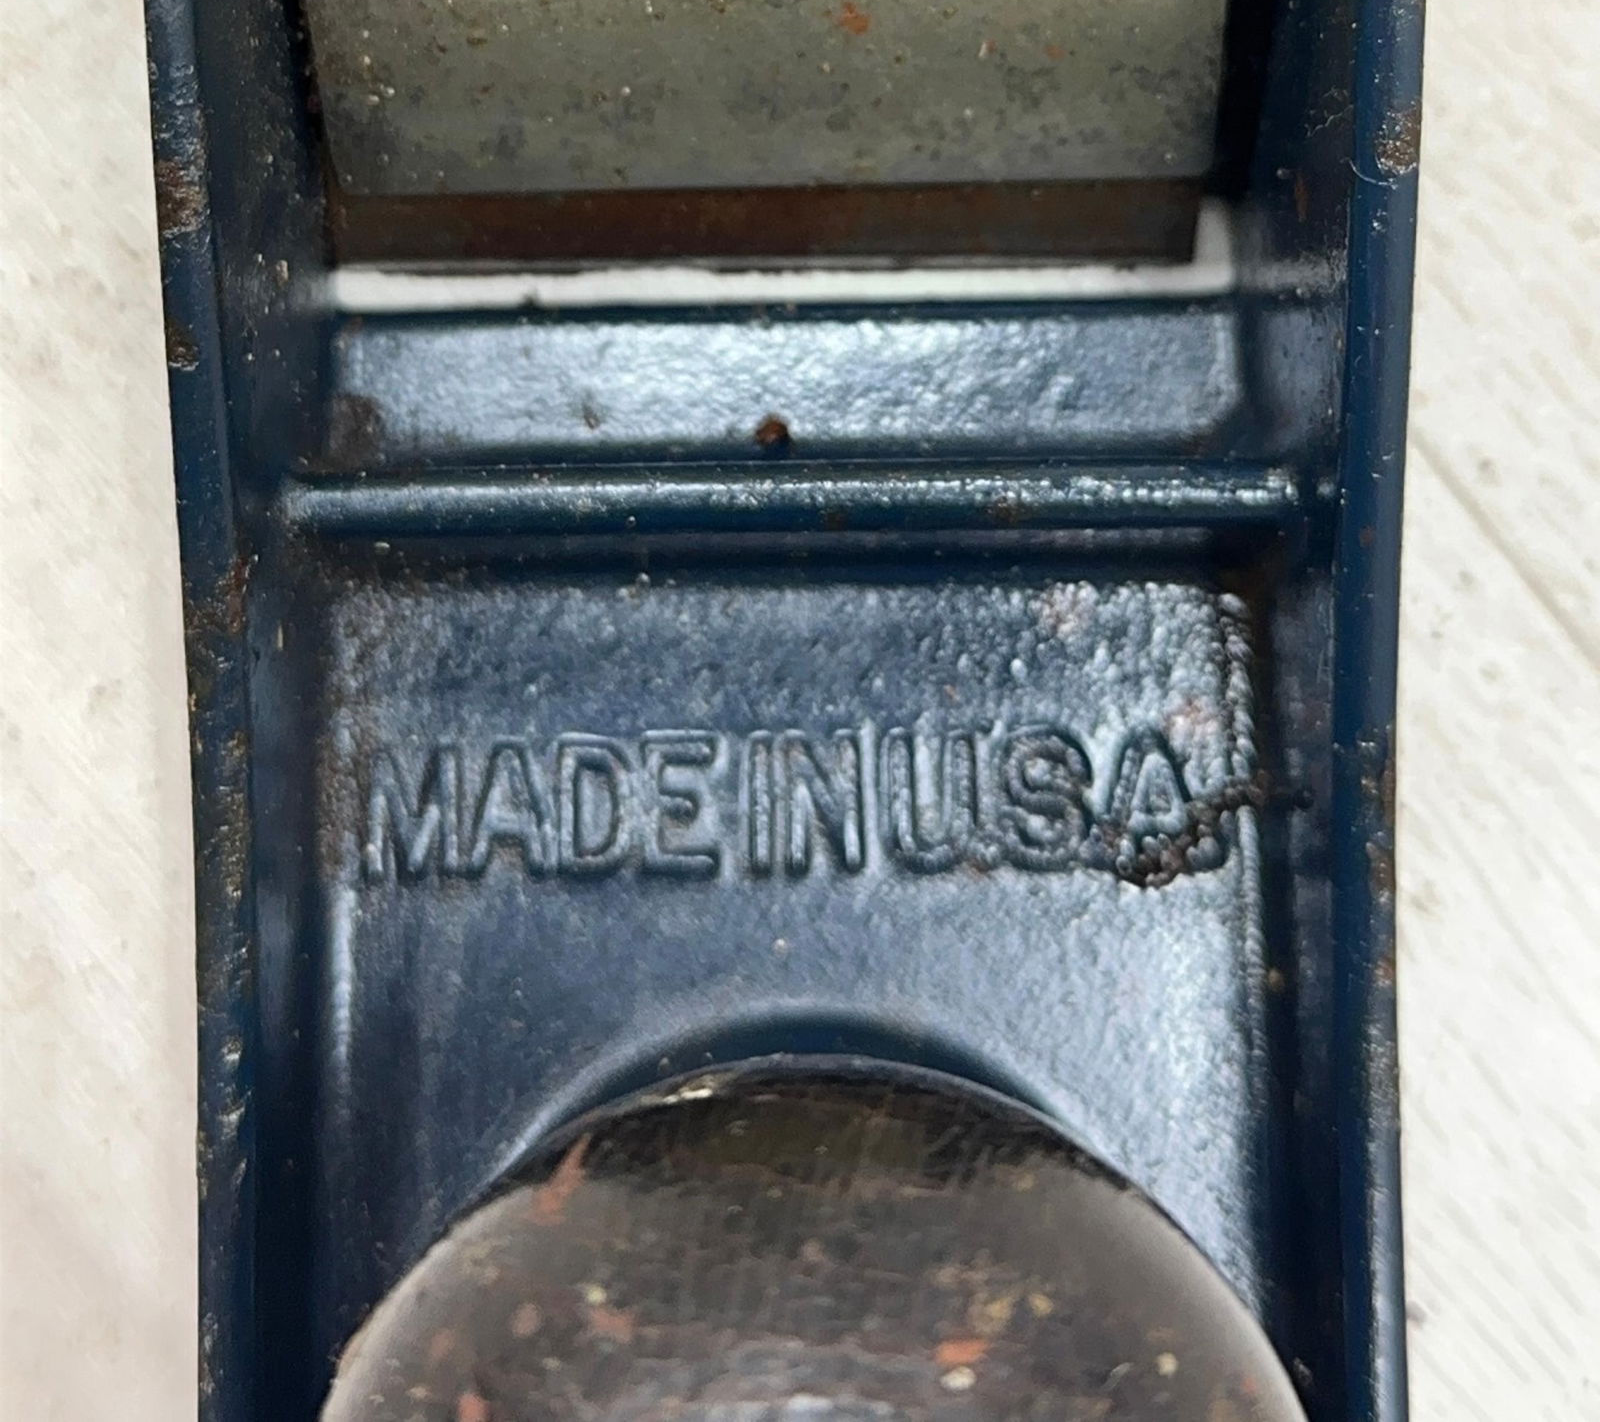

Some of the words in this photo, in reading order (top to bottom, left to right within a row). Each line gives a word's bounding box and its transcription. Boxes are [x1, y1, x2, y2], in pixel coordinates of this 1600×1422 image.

[362, 729, 722, 880] MADE
[743, 727, 867, 875] IN
[880, 720, 1232, 886] USA
